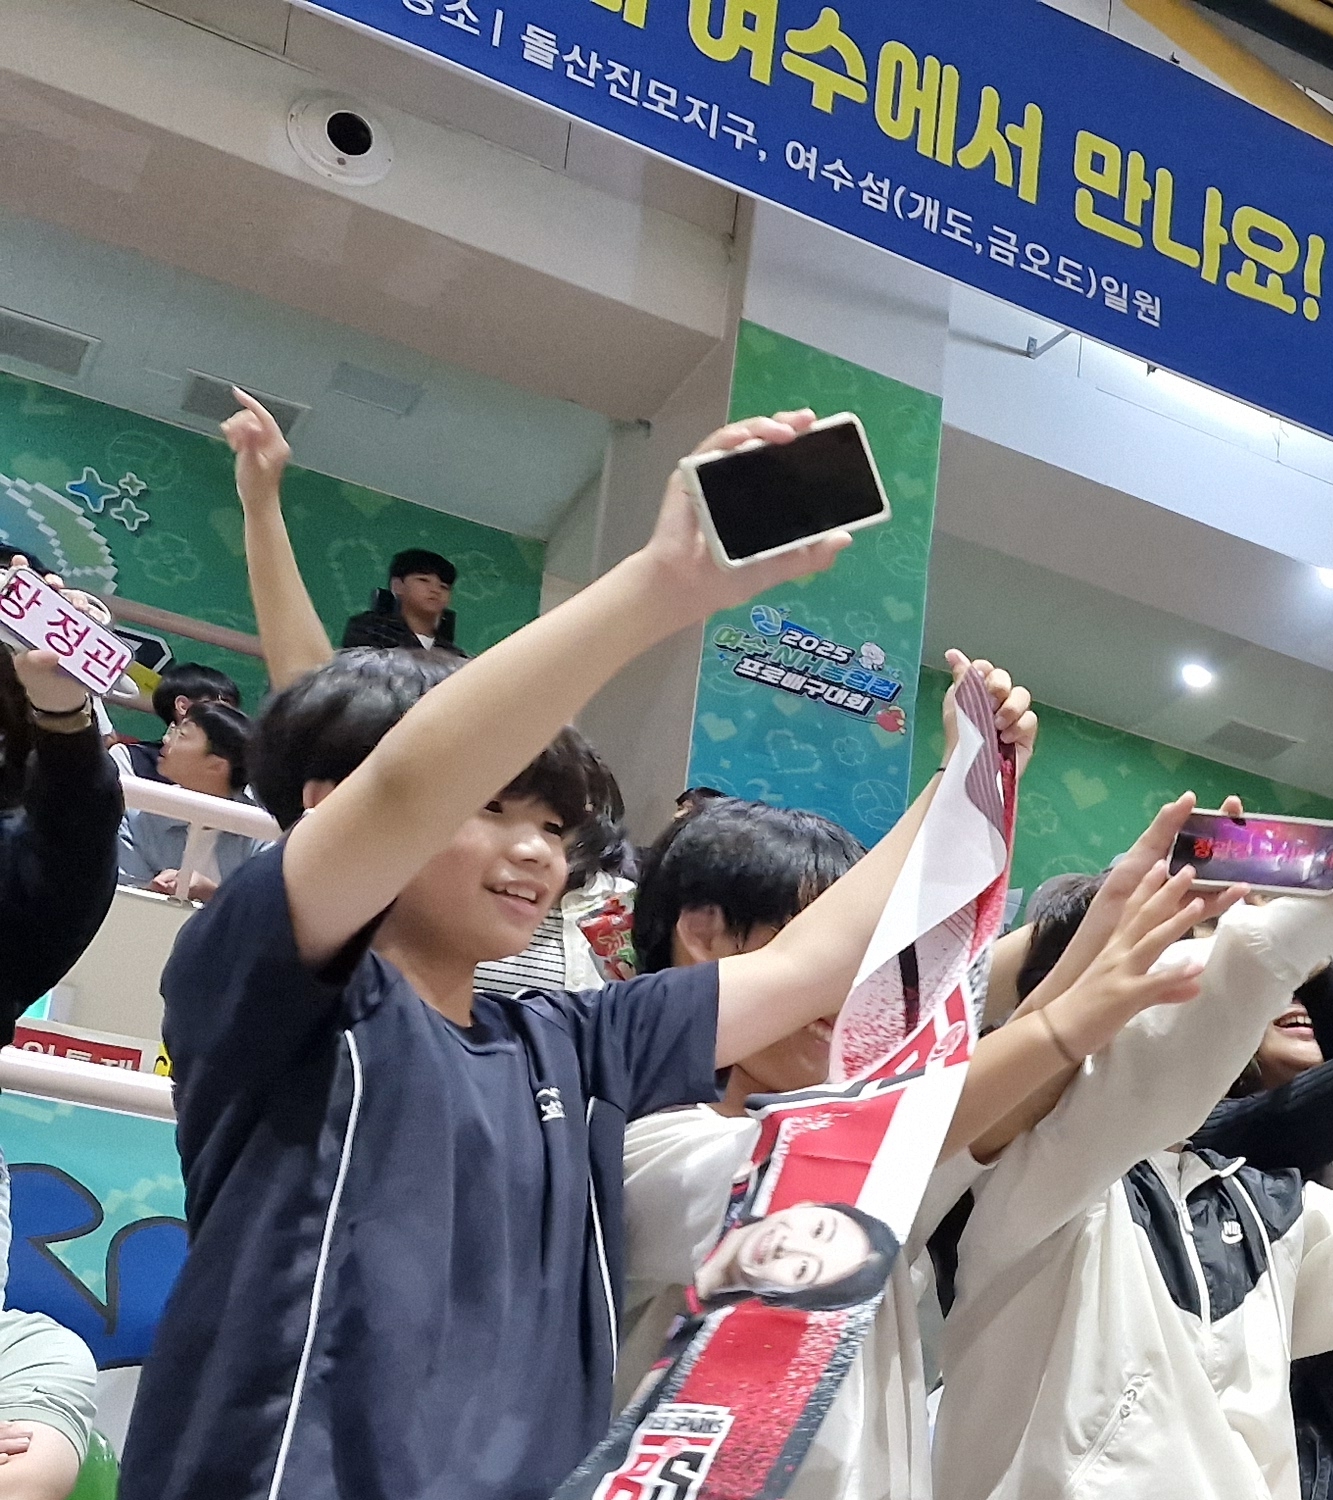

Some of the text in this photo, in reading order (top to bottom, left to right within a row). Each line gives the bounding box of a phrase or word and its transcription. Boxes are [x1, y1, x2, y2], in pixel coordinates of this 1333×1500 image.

[520, 22, 768, 163] 돌산진모지구,
[687, 0, 1327, 322] 여수에서 만나요!
[734, 656, 874, 713] 프로배구대회
[780, 629, 855, 664] 2025
